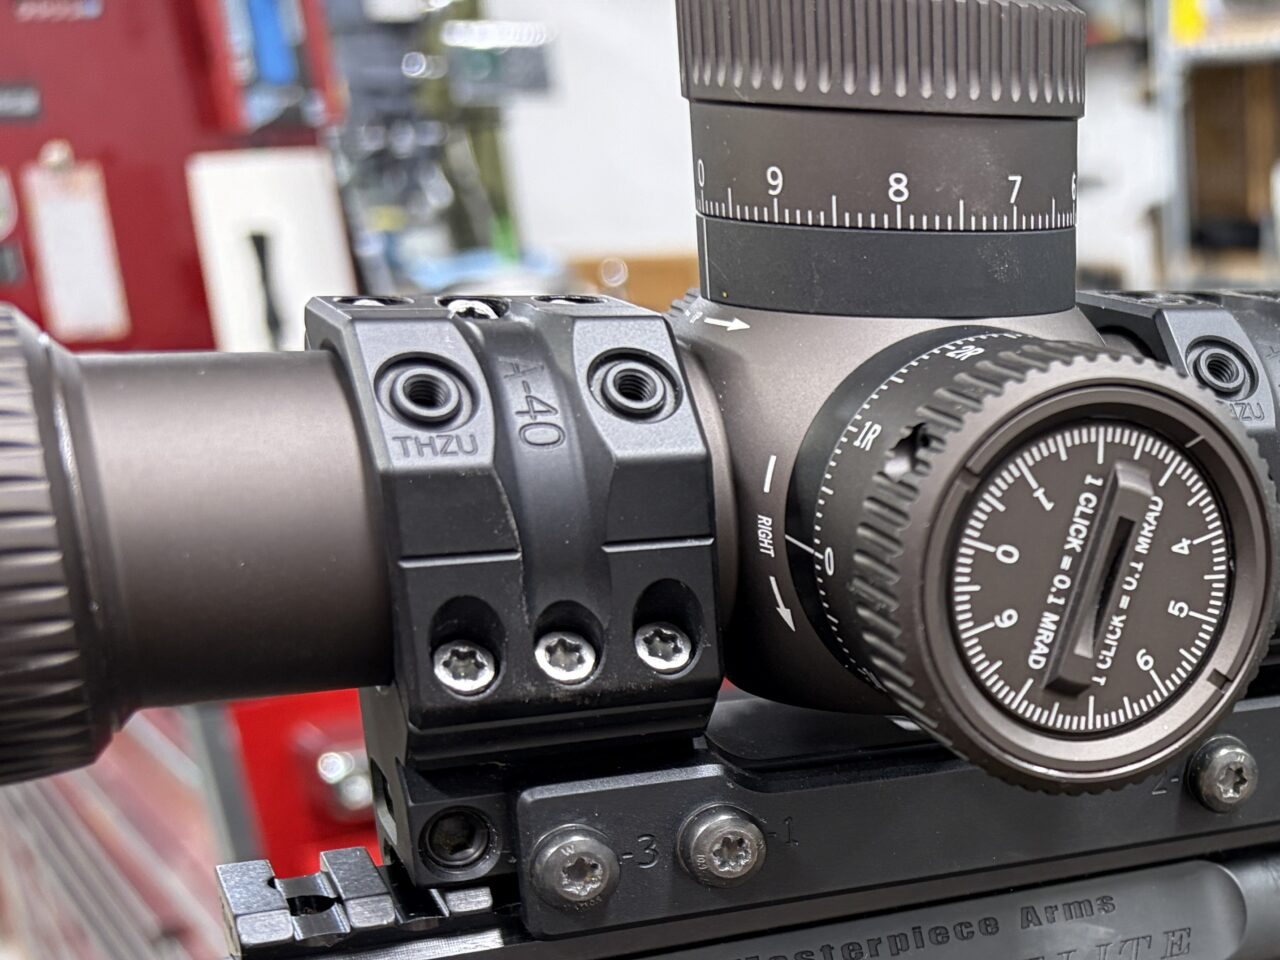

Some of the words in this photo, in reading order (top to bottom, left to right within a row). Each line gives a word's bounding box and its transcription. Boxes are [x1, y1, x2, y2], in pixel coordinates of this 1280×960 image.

[766, 165, 783, 196] 9
[887, 172, 909, 202] 8
[1007, 175, 1023, 204] 7
[945, 345, 985, 361] 2R
[499, 357, 567, 451] A-40
[392, 434, 479, 459] THZU
[853, 420, 882, 451] 1R
[1084, 474, 1104, 487] 1
[757, 514, 774, 558] RIGHT
[1064, 491, 1098, 553] CLICK
[995, 544, 1020, 564] 0
[1171, 537, 1192, 555] 4
[824, 547, 834, 576] 0
[1047, 573, 1072, 606] 0.1
[1167, 600, 1190, 619] 5
[1027, 611, 1060, 670] MRAD
[1135, 648, 1155, 672] 6
[1019, 892, 1117, 930] Arms
